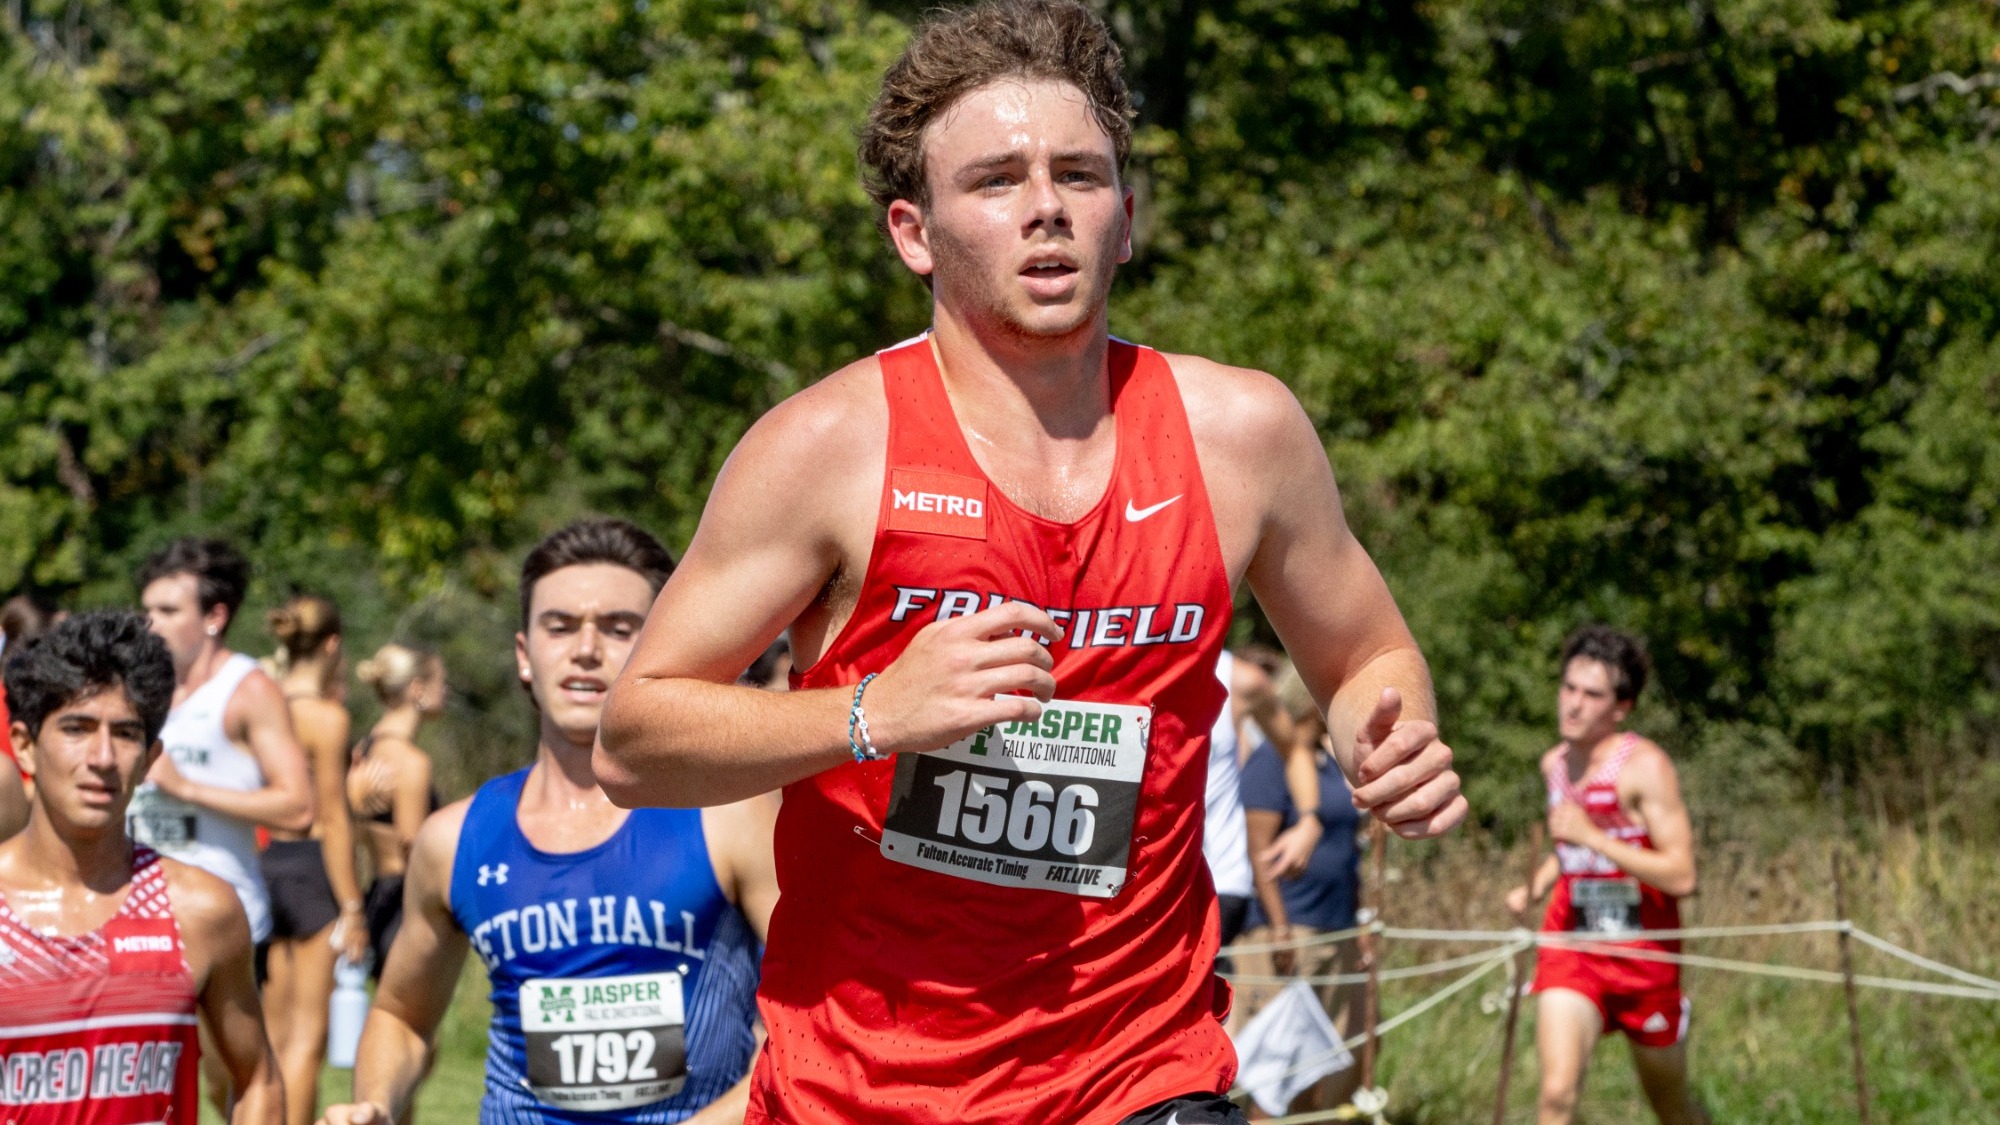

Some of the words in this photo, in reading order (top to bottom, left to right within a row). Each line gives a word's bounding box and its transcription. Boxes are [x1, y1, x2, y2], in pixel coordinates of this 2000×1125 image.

[893, 489, 983, 518] METRO
[890, 584, 1206, 651] FAFIELD
[1002, 739, 1025, 759] FALL
[1027, 741, 1043, 761] XC
[1044, 743, 1117, 768] INVITATIONAL
[933, 769, 1099, 856] 1566
[916, 842, 948, 864] Fulton
[949, 849, 994, 873] Accurate
[995, 858, 1030, 880] Timing
[1045, 865, 1103, 886] FAT.LIVE
[469, 898, 579, 972] ETON
[588, 895, 706, 960] HALL
[582, 981, 661, 1005] JASPER
[0, 1047, 89, 1106] CRED
[551, 1030, 658, 1084] 1792
